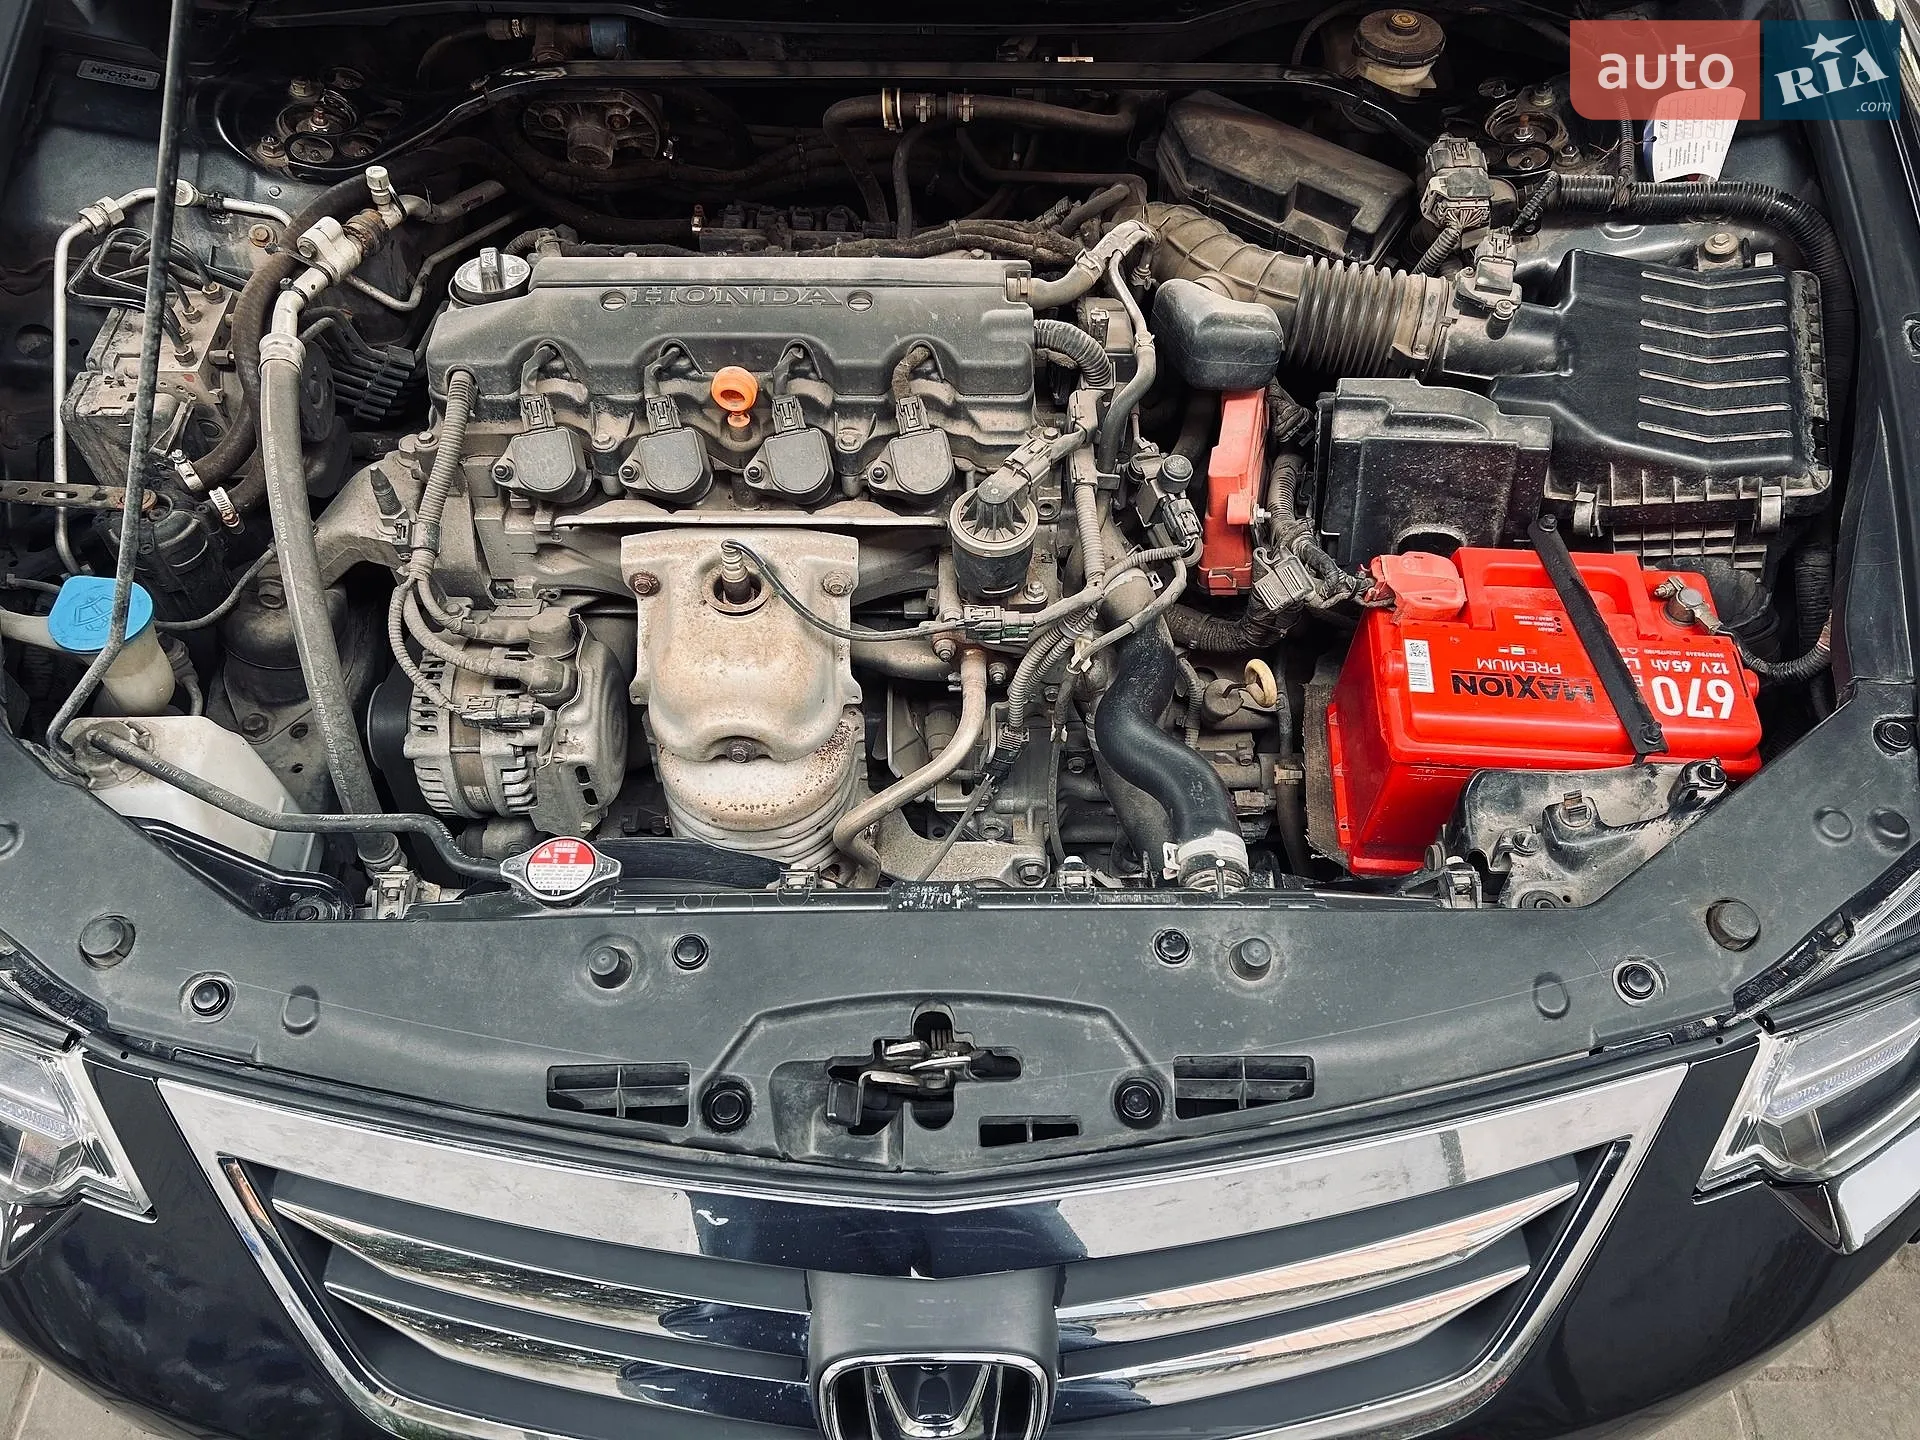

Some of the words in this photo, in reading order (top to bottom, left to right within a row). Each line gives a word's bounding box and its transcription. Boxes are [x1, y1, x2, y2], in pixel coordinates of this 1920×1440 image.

[630, 285, 843, 308] HONDA
[1476, 657, 1562, 676] PREMIUM
[1450, 674, 1596, 705] MAXION
[1651, 675, 1735, 720] 670
